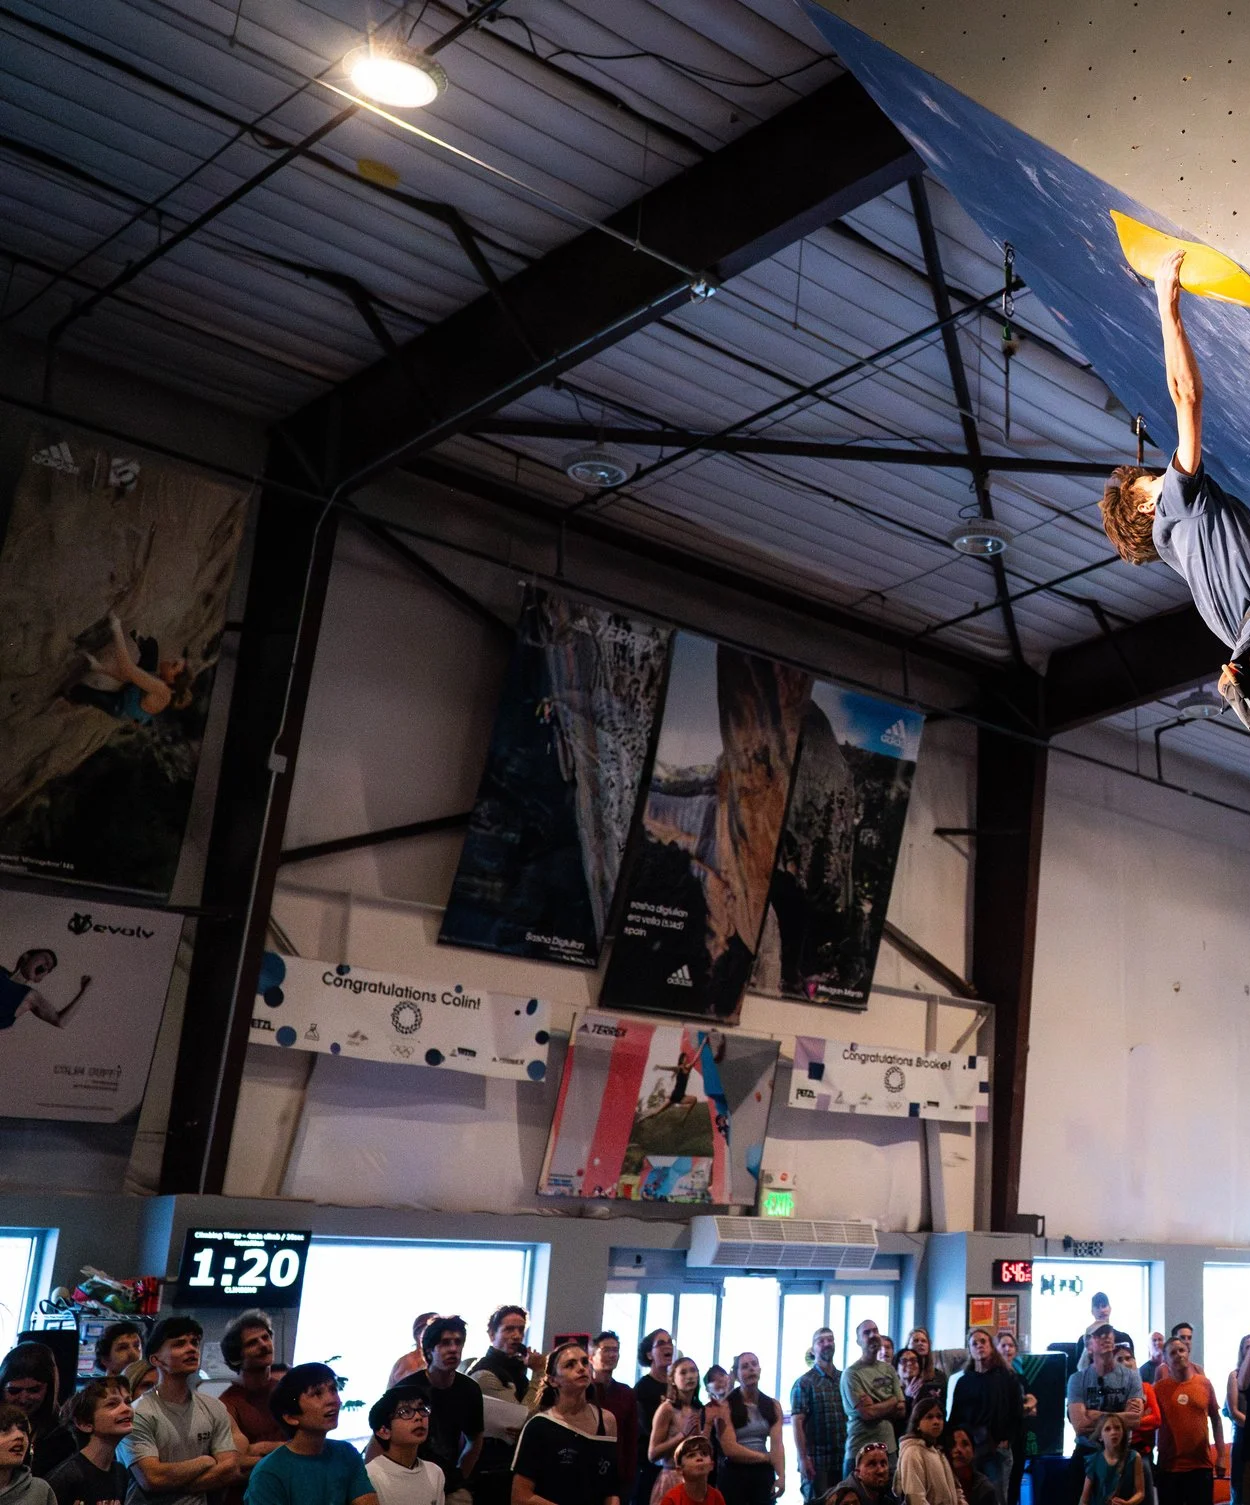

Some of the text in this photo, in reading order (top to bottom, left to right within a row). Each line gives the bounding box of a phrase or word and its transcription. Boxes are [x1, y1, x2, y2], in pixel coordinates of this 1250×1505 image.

[94, 924, 154, 938] evolv
[322, 971, 481, 1011] Congratulations Colin!
[592, 1024, 628, 1038] TERREX
[842, 1050, 951, 1071] Congratulations Brooke!
[189, 1248, 300, 1287] 1:20
